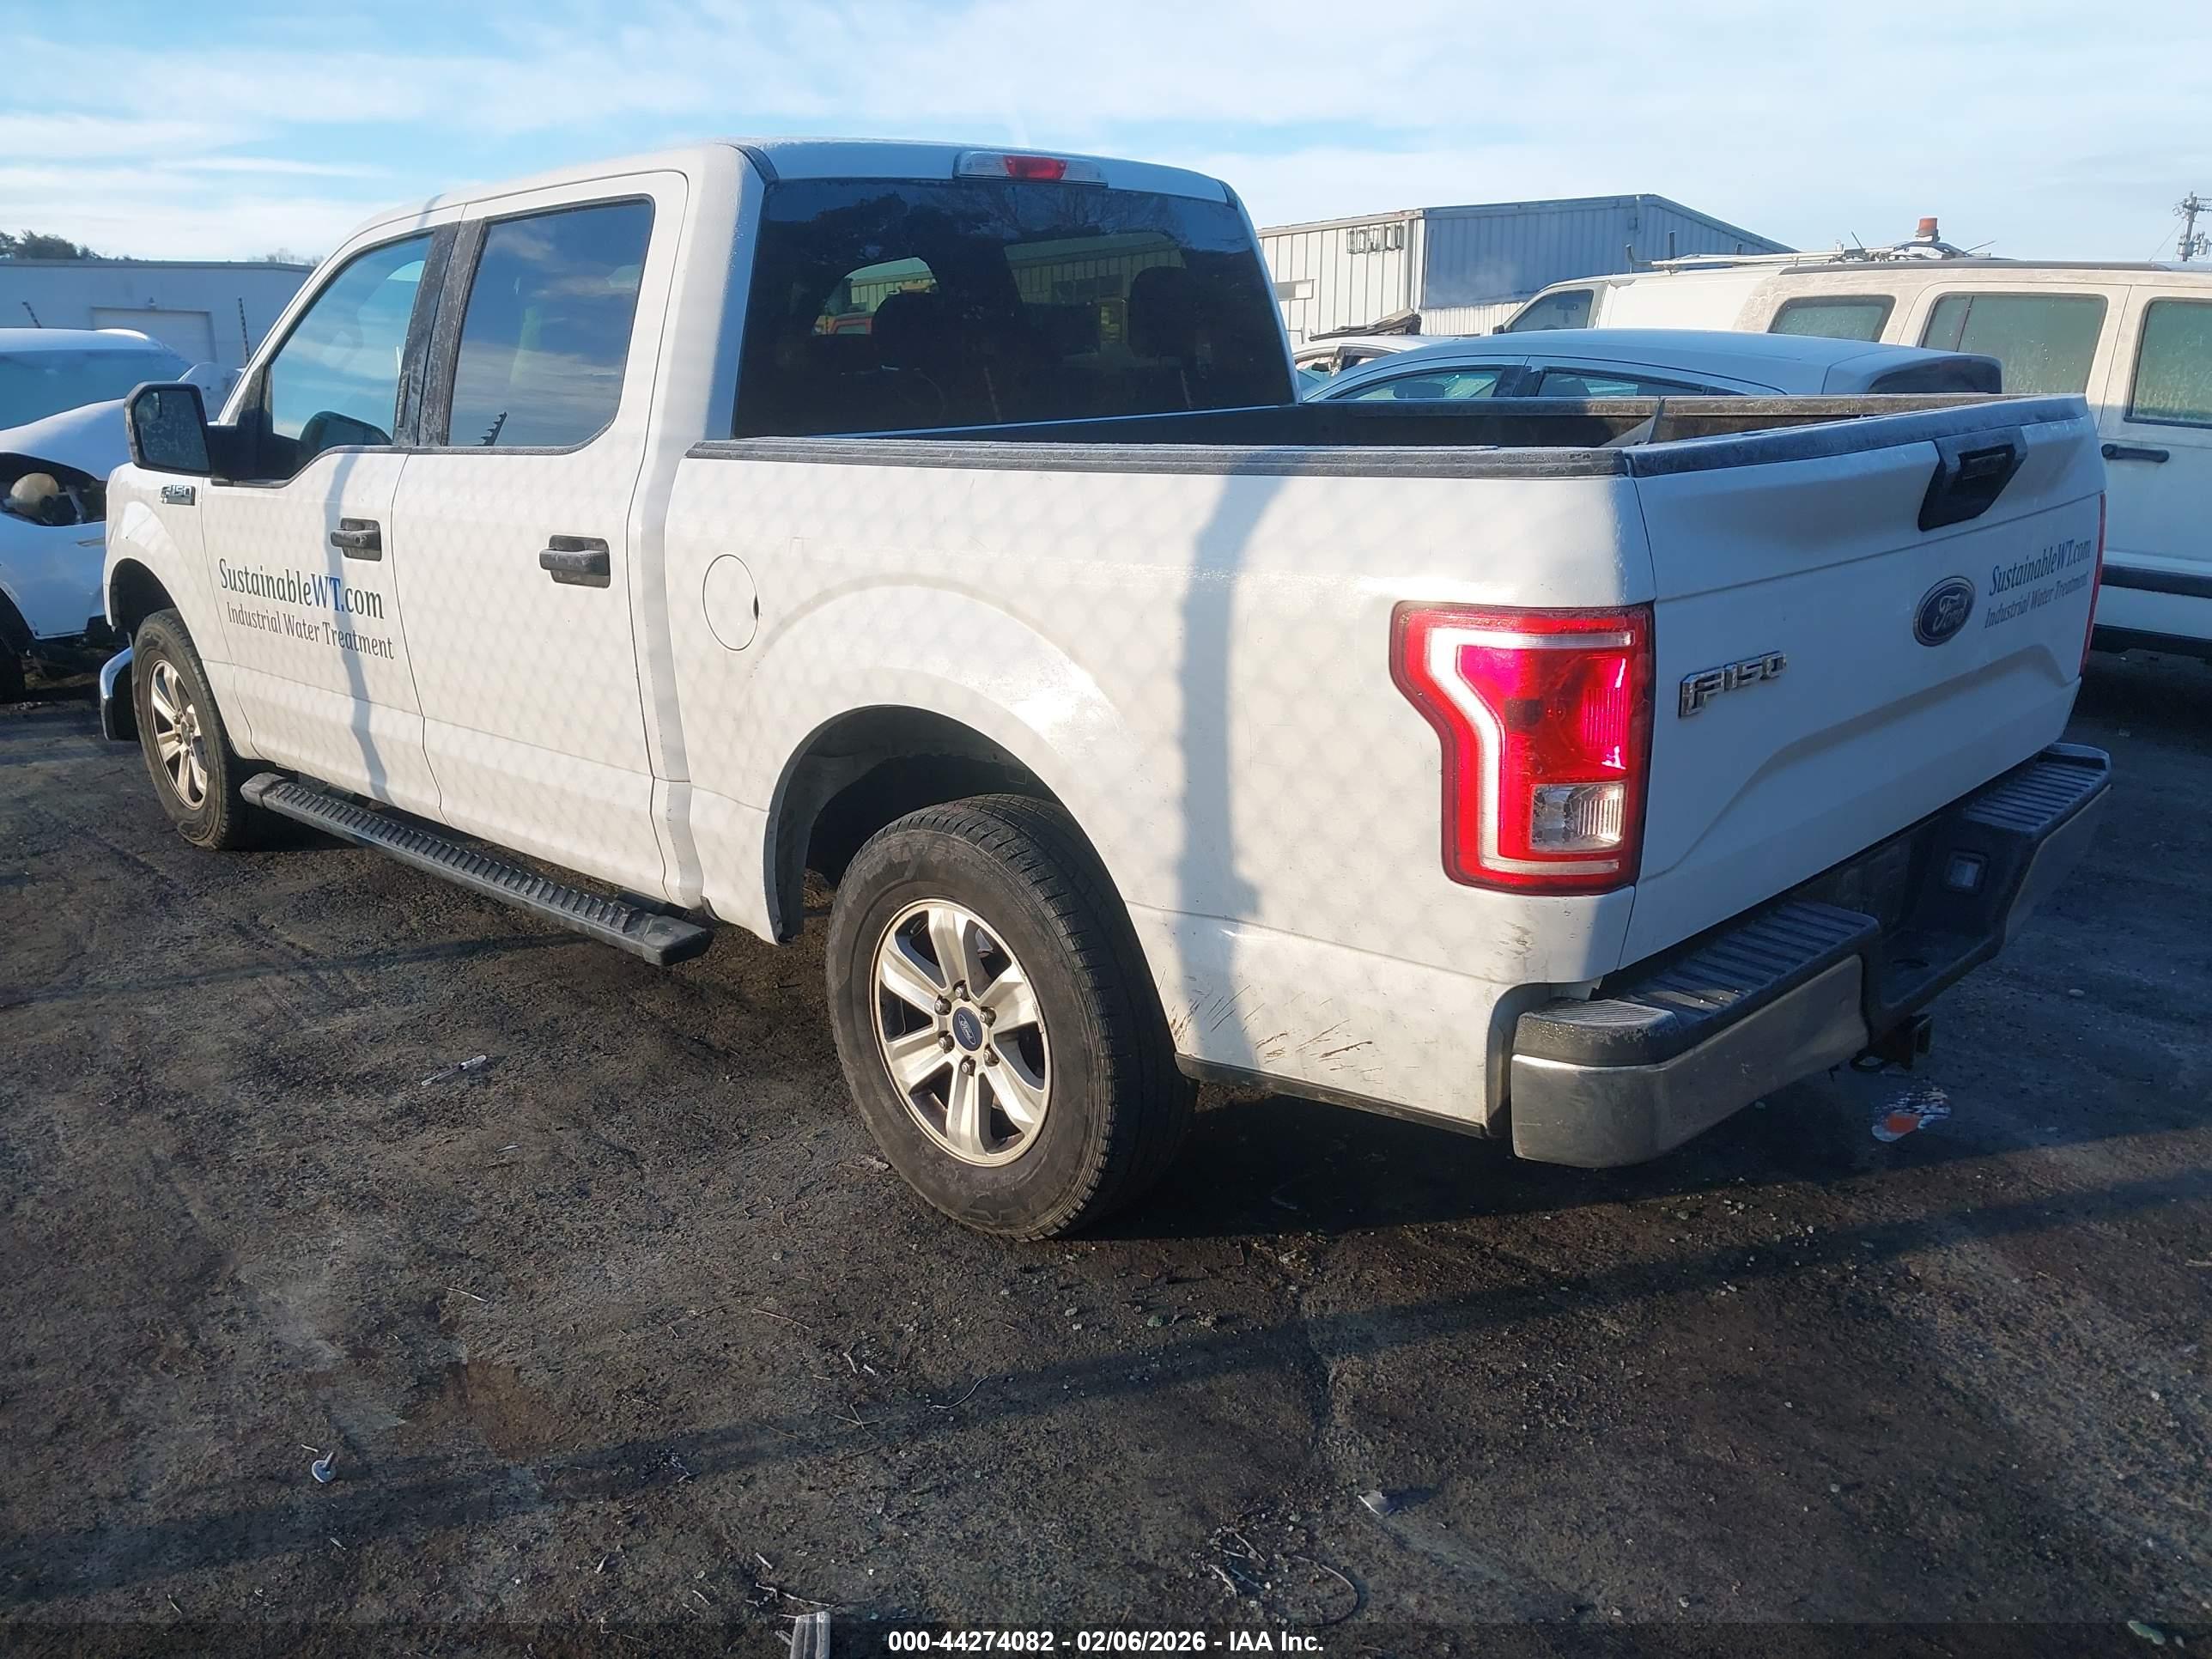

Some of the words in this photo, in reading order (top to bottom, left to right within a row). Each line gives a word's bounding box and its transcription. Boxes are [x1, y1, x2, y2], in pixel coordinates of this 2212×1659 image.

[219, 558, 384, 619] SustainableWT.com
[1989, 538, 2092, 596] SustainableWT.com
[227, 602, 282, 635] Industrial
[283, 612, 319, 643] Water
[322, 621, 394, 660] Treatment
[1984, 587, 2031, 629] Industrial
[2031, 588, 2054, 611] Water
